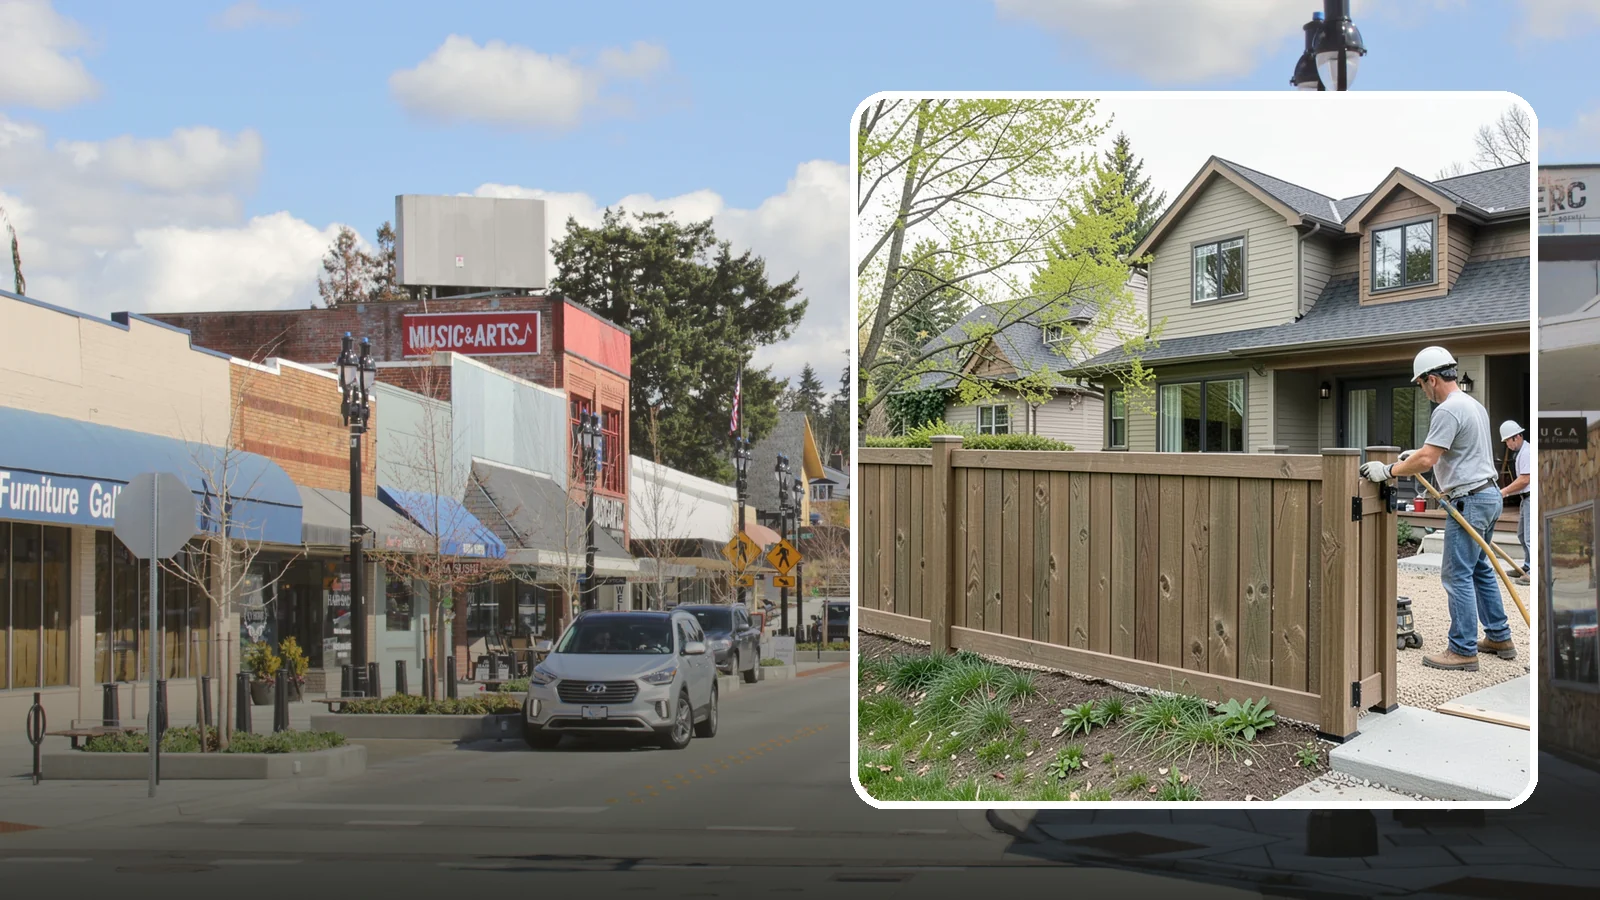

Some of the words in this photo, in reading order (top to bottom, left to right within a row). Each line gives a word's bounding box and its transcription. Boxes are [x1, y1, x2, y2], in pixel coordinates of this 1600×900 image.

[1540, 427, 1578, 436] UGA
[0, 471, 79, 515] Furniture
[89, 482, 121, 519] Gal
